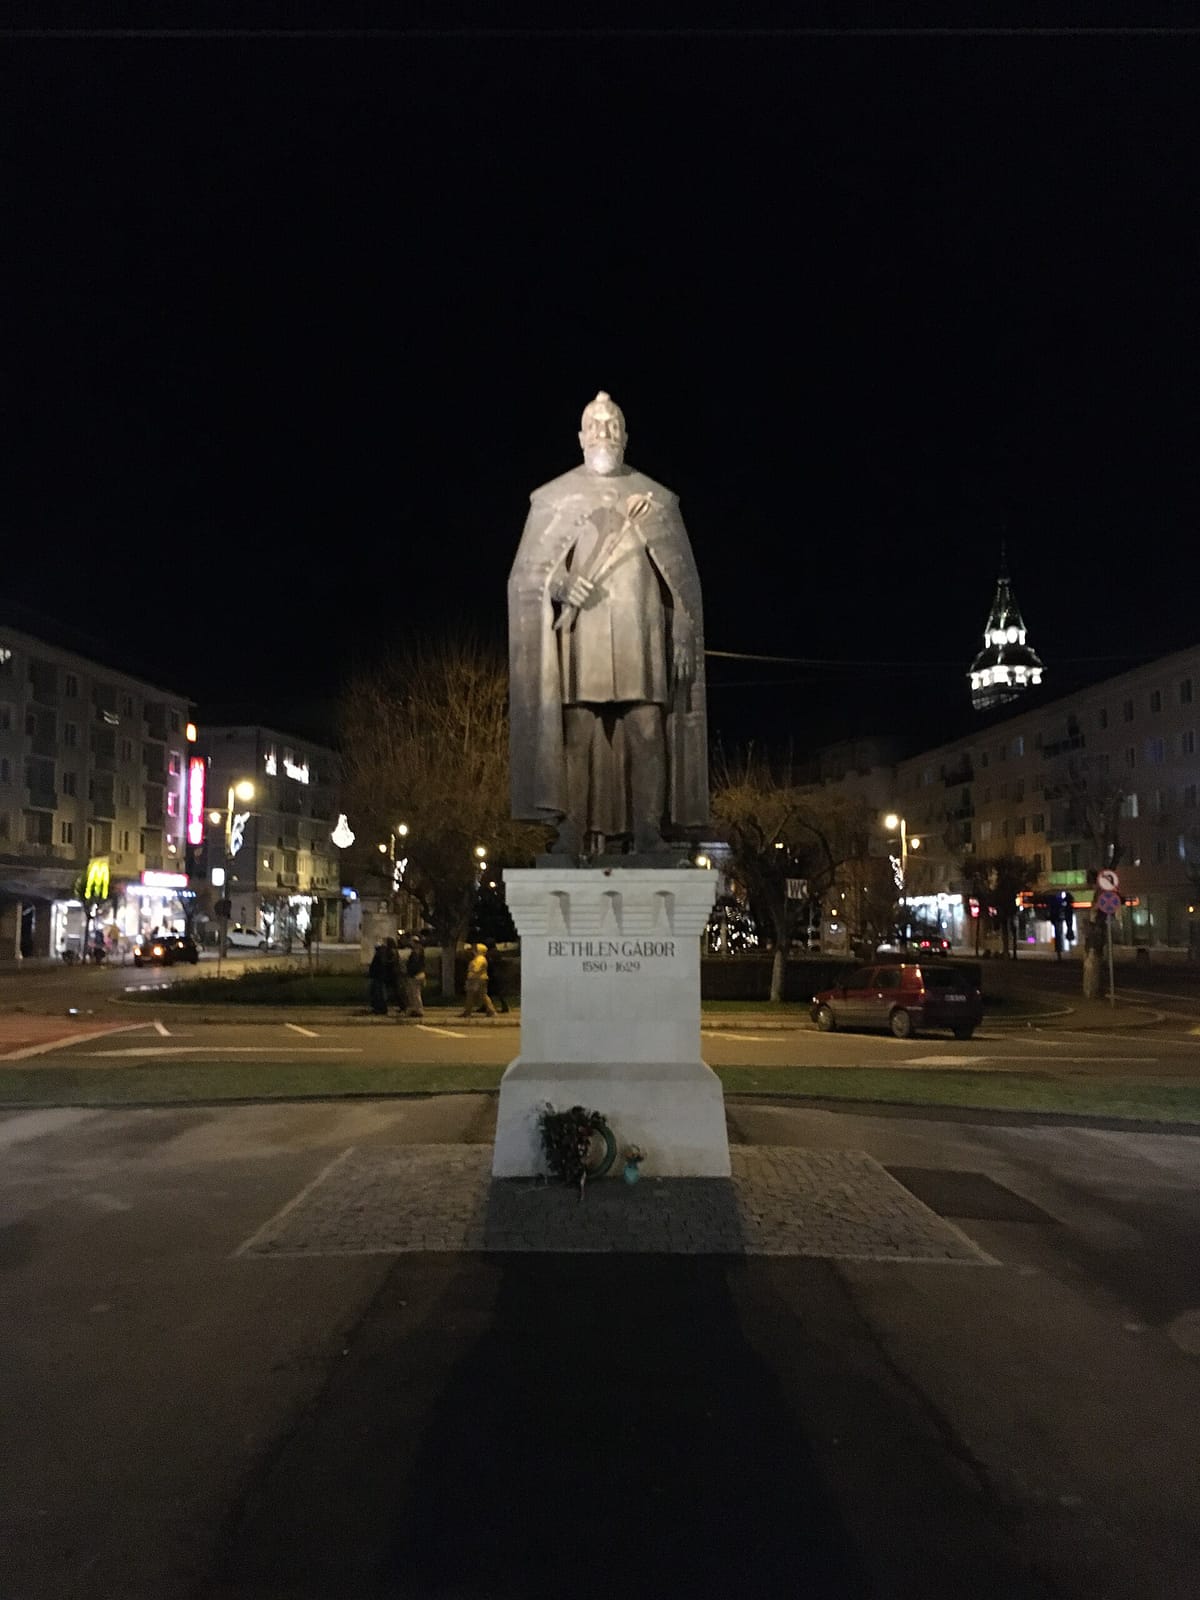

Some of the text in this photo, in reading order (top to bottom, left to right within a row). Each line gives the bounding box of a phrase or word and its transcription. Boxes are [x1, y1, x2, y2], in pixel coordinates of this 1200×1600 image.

[548, 941, 618, 956] BETHLEN
[582, 961, 607, 972] 1580
[615, 961, 640, 972] 1629
